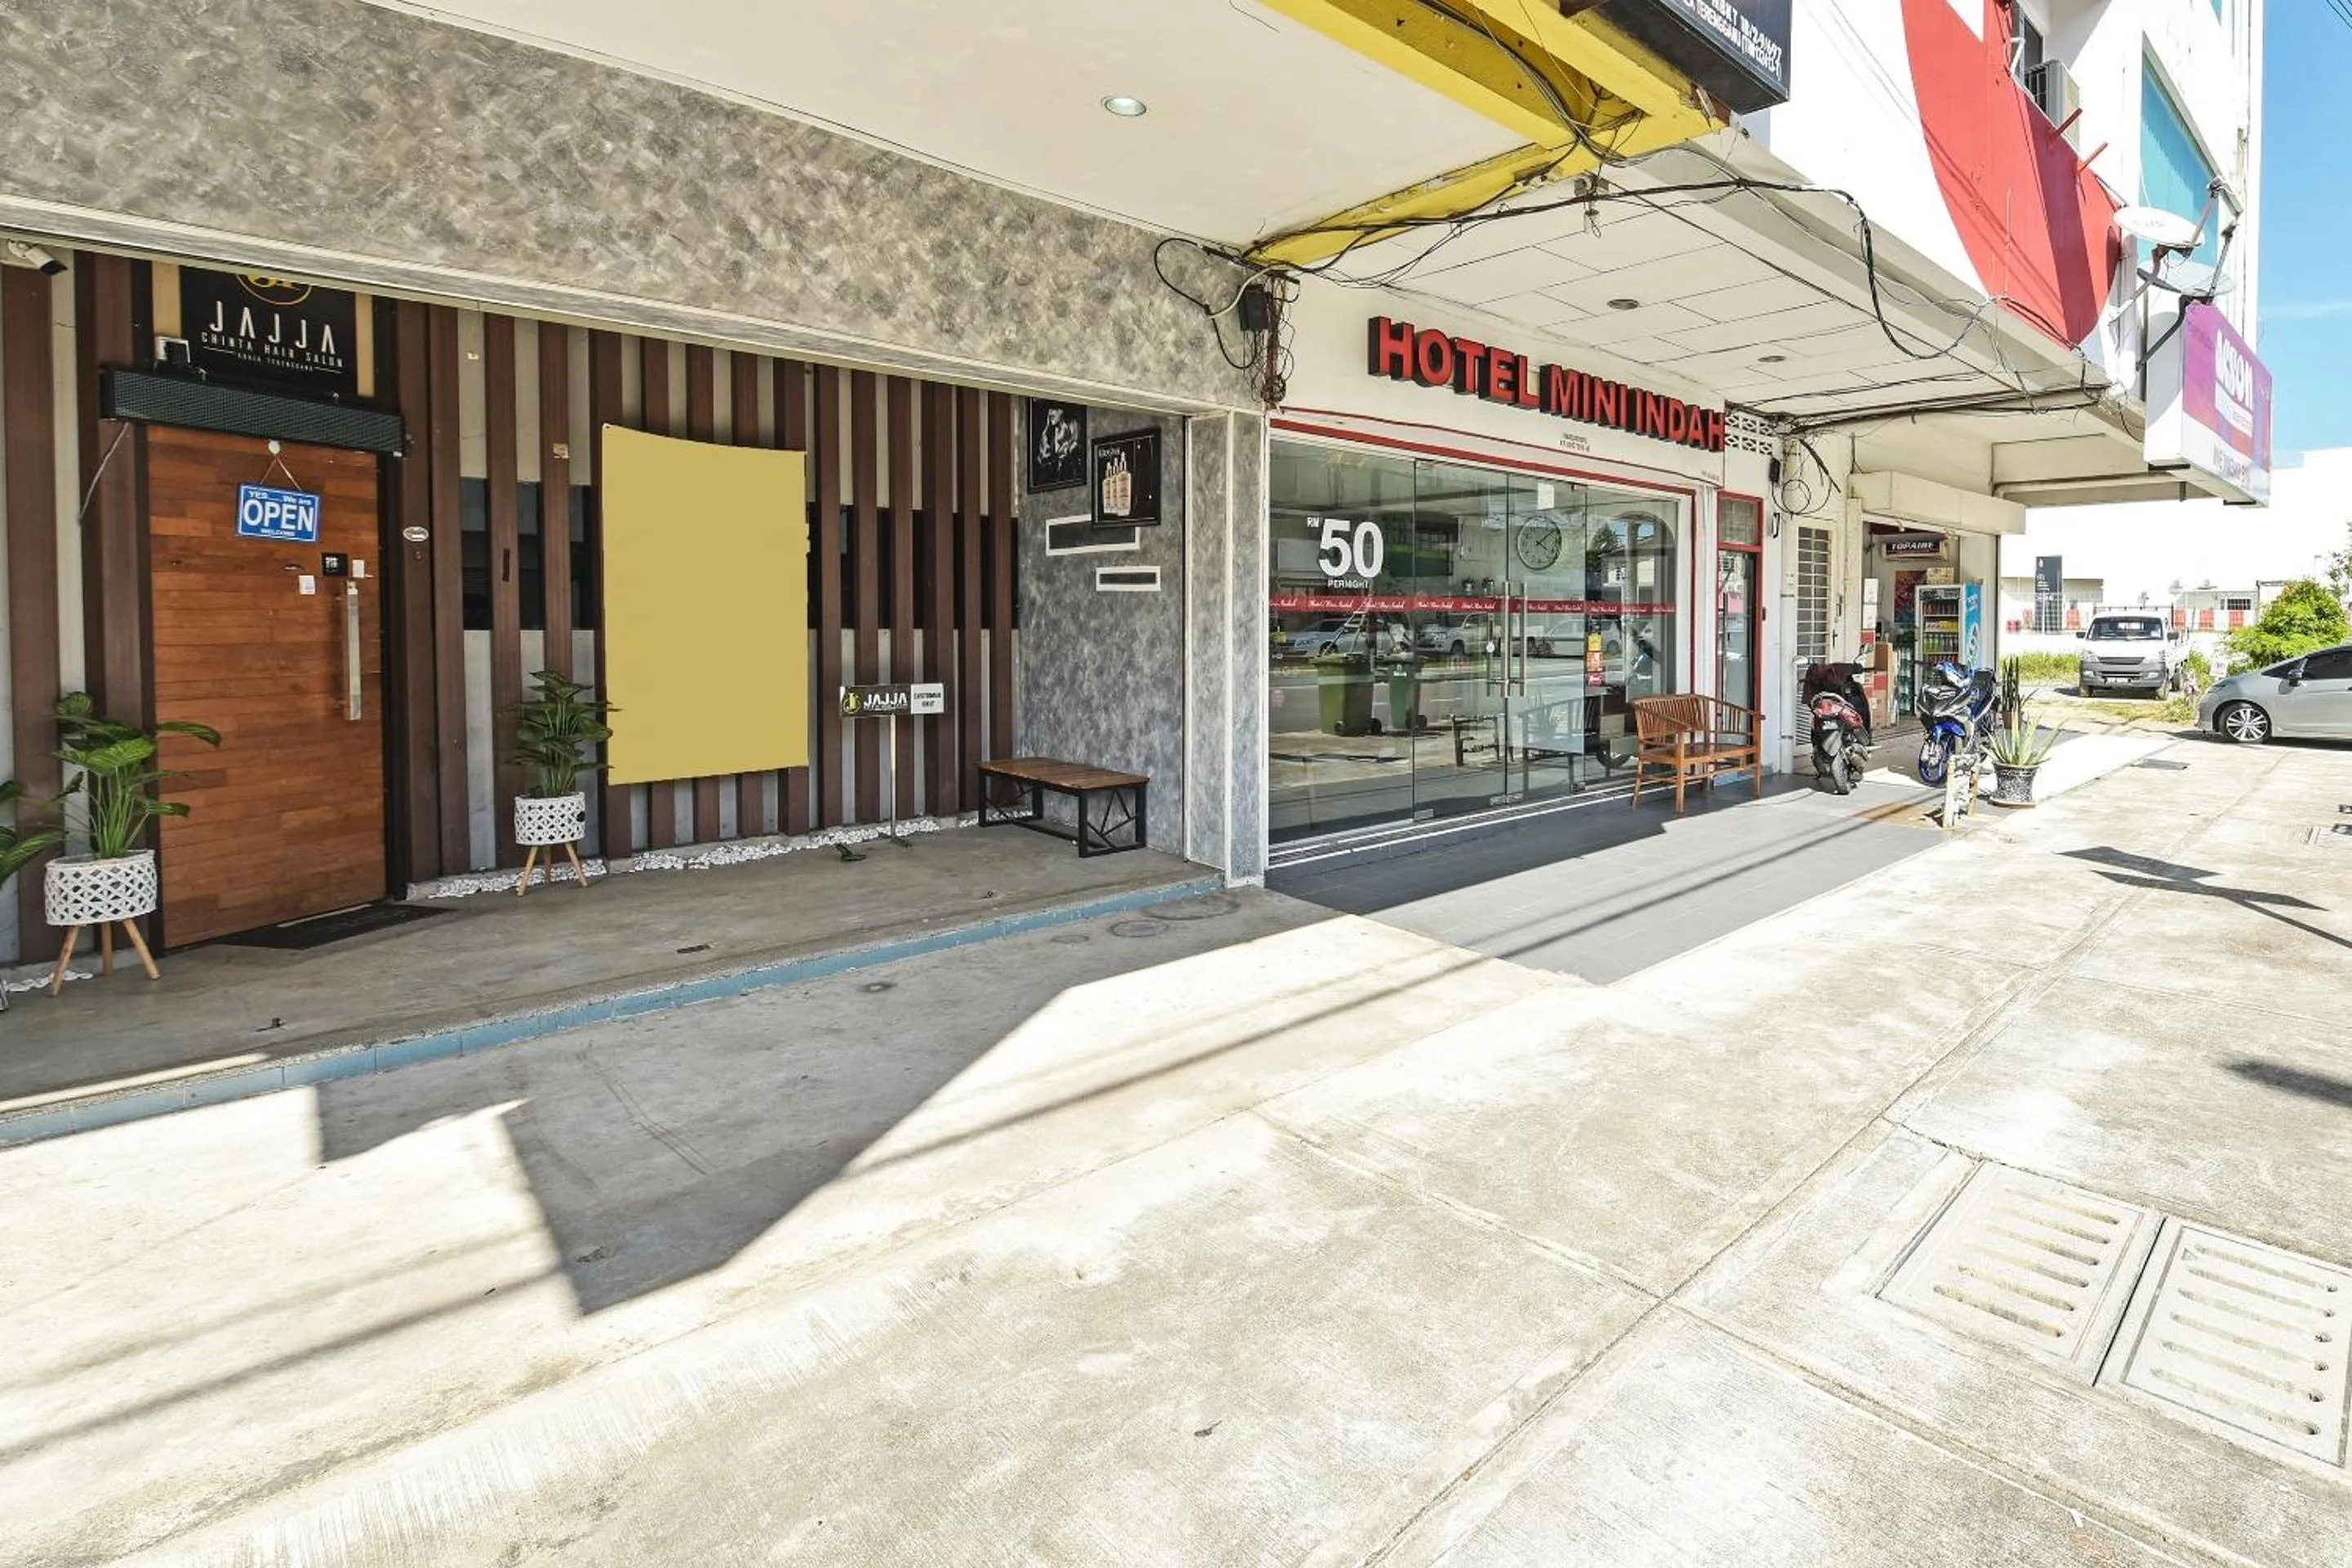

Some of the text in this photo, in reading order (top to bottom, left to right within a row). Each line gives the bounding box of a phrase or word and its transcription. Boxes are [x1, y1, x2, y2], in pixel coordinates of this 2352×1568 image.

[209, 301, 336, 354] JAJJA
[202, 332, 343, 368] CHINTA HAIR SALON
[1369, 316, 1726, 452] HOTEL MINI INDAH
[243, 498, 314, 532] OPEN
[1307, 517, 1320, 528] RM
[1319, 518, 1384, 578] 50
[864, 693, 907, 706] JAJJA
